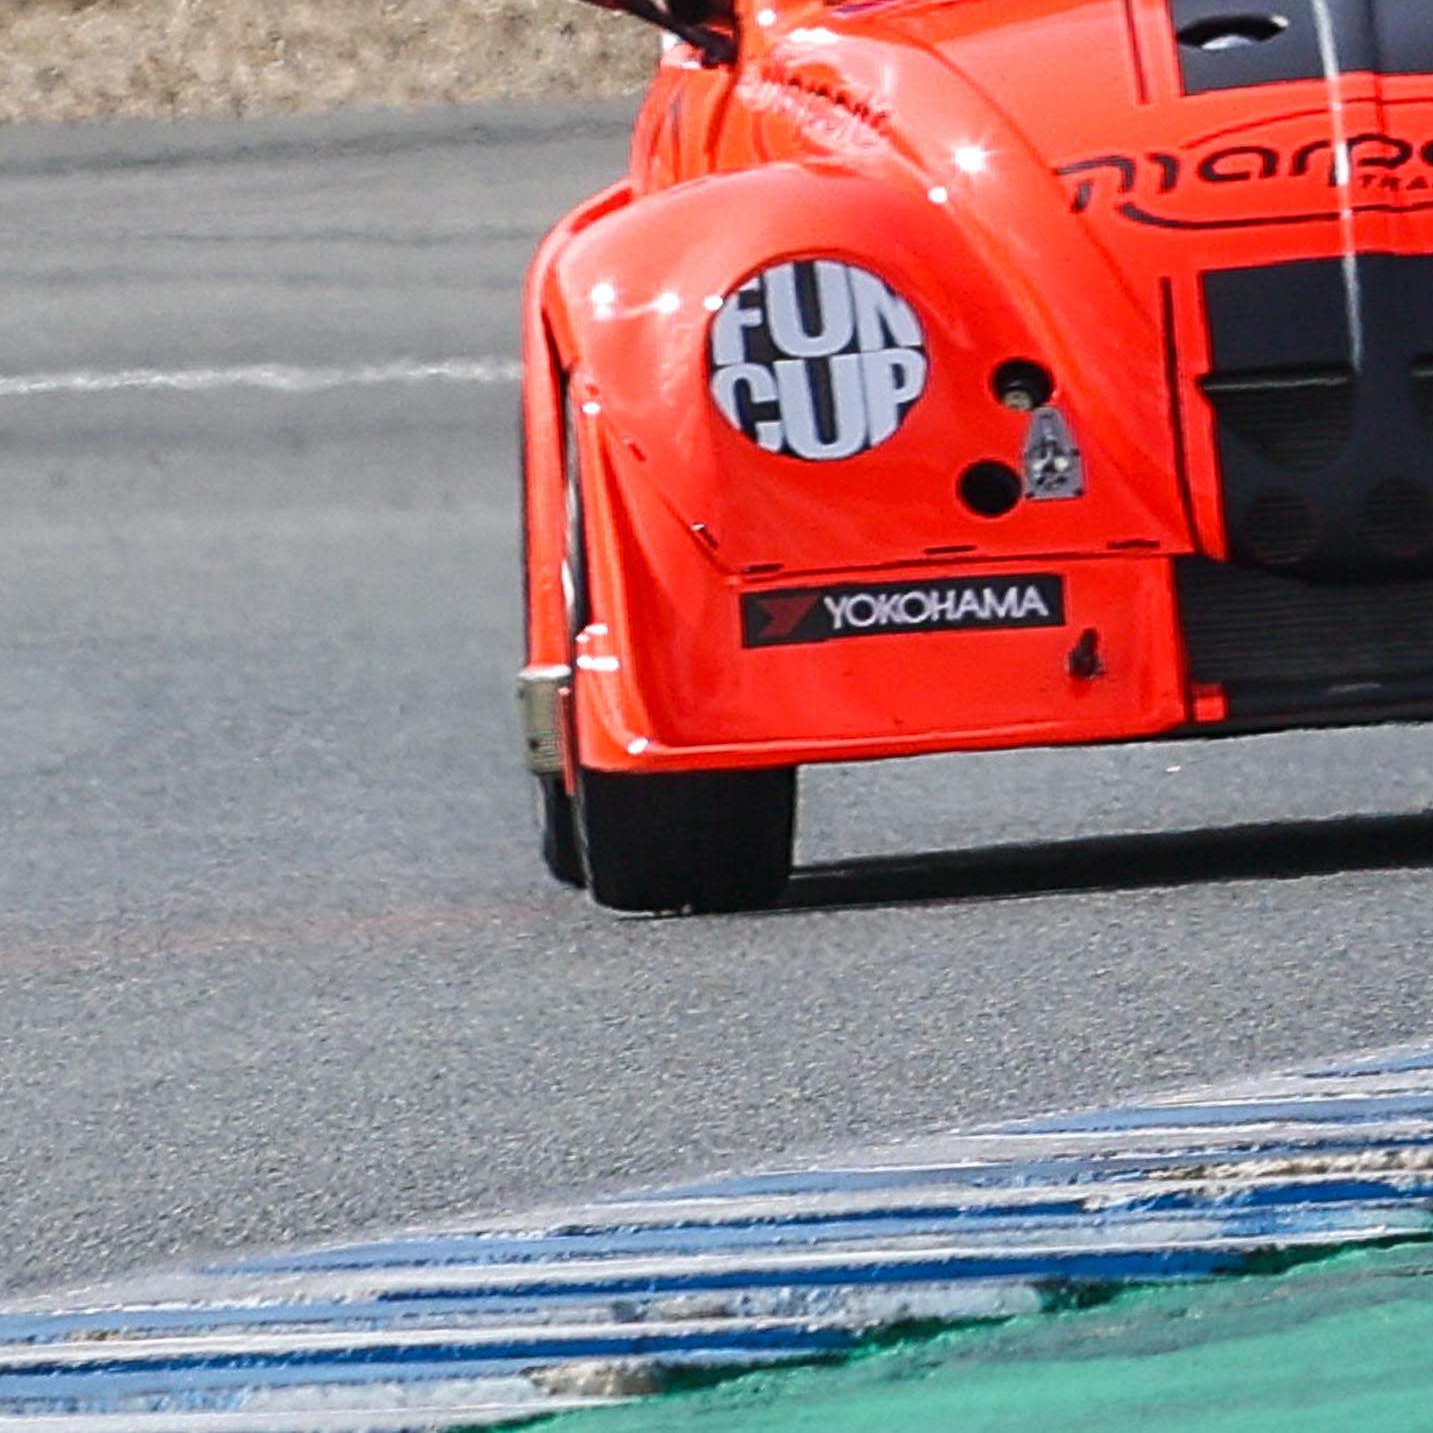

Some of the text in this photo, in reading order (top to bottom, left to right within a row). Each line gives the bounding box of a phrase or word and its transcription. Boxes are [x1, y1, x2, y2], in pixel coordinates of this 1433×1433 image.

[711, 259, 924, 366] FUN
[710, 347, 928, 460] CUP
[824, 585, 1049, 629] YOKOHAMA
